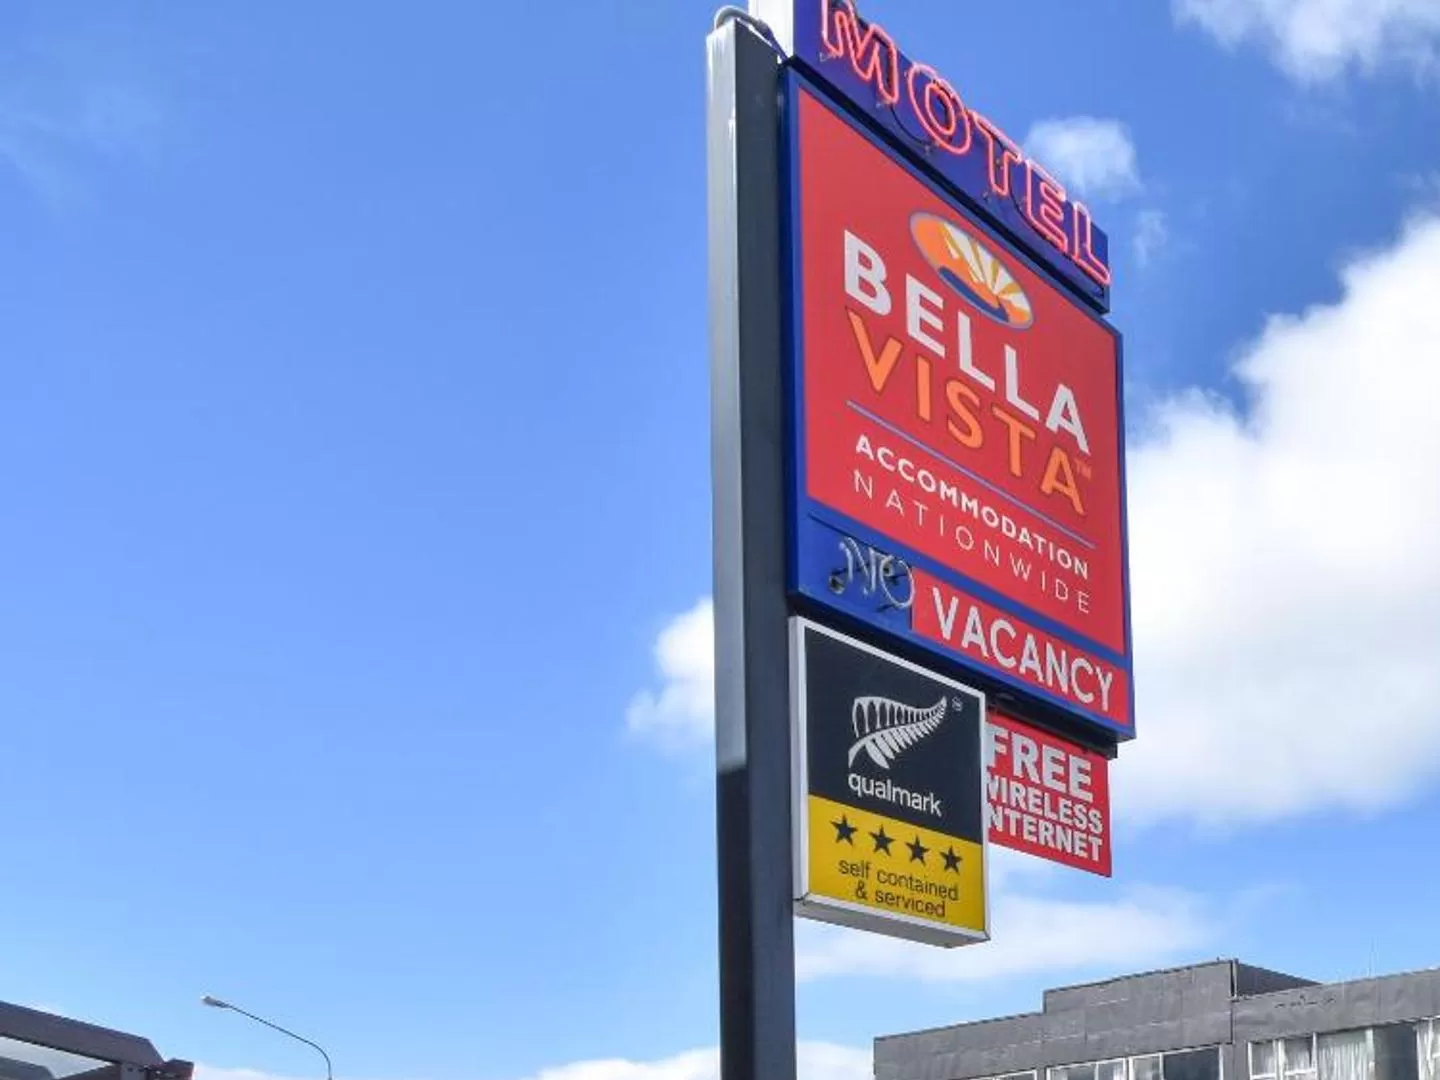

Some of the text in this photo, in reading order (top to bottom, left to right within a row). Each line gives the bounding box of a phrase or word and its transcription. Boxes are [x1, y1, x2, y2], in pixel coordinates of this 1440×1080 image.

[820, 0, 1112, 287] MOTEL
[844, 229, 1090, 456] BELLA
[845, 305, 1085, 516] VISTA
[853, 469, 1090, 614] NATIONWIDE
[855, 434, 1089, 580] ACCOMMODATION
[932, 586, 1113, 712] VACANCY
[848, 773, 942, 817] qualmark
[984, 721, 1093, 803] FREE
[838, 859, 959, 900] self contained
[986, 802, 1103, 861] NTERNET
[855, 880, 946, 917] & serviced
